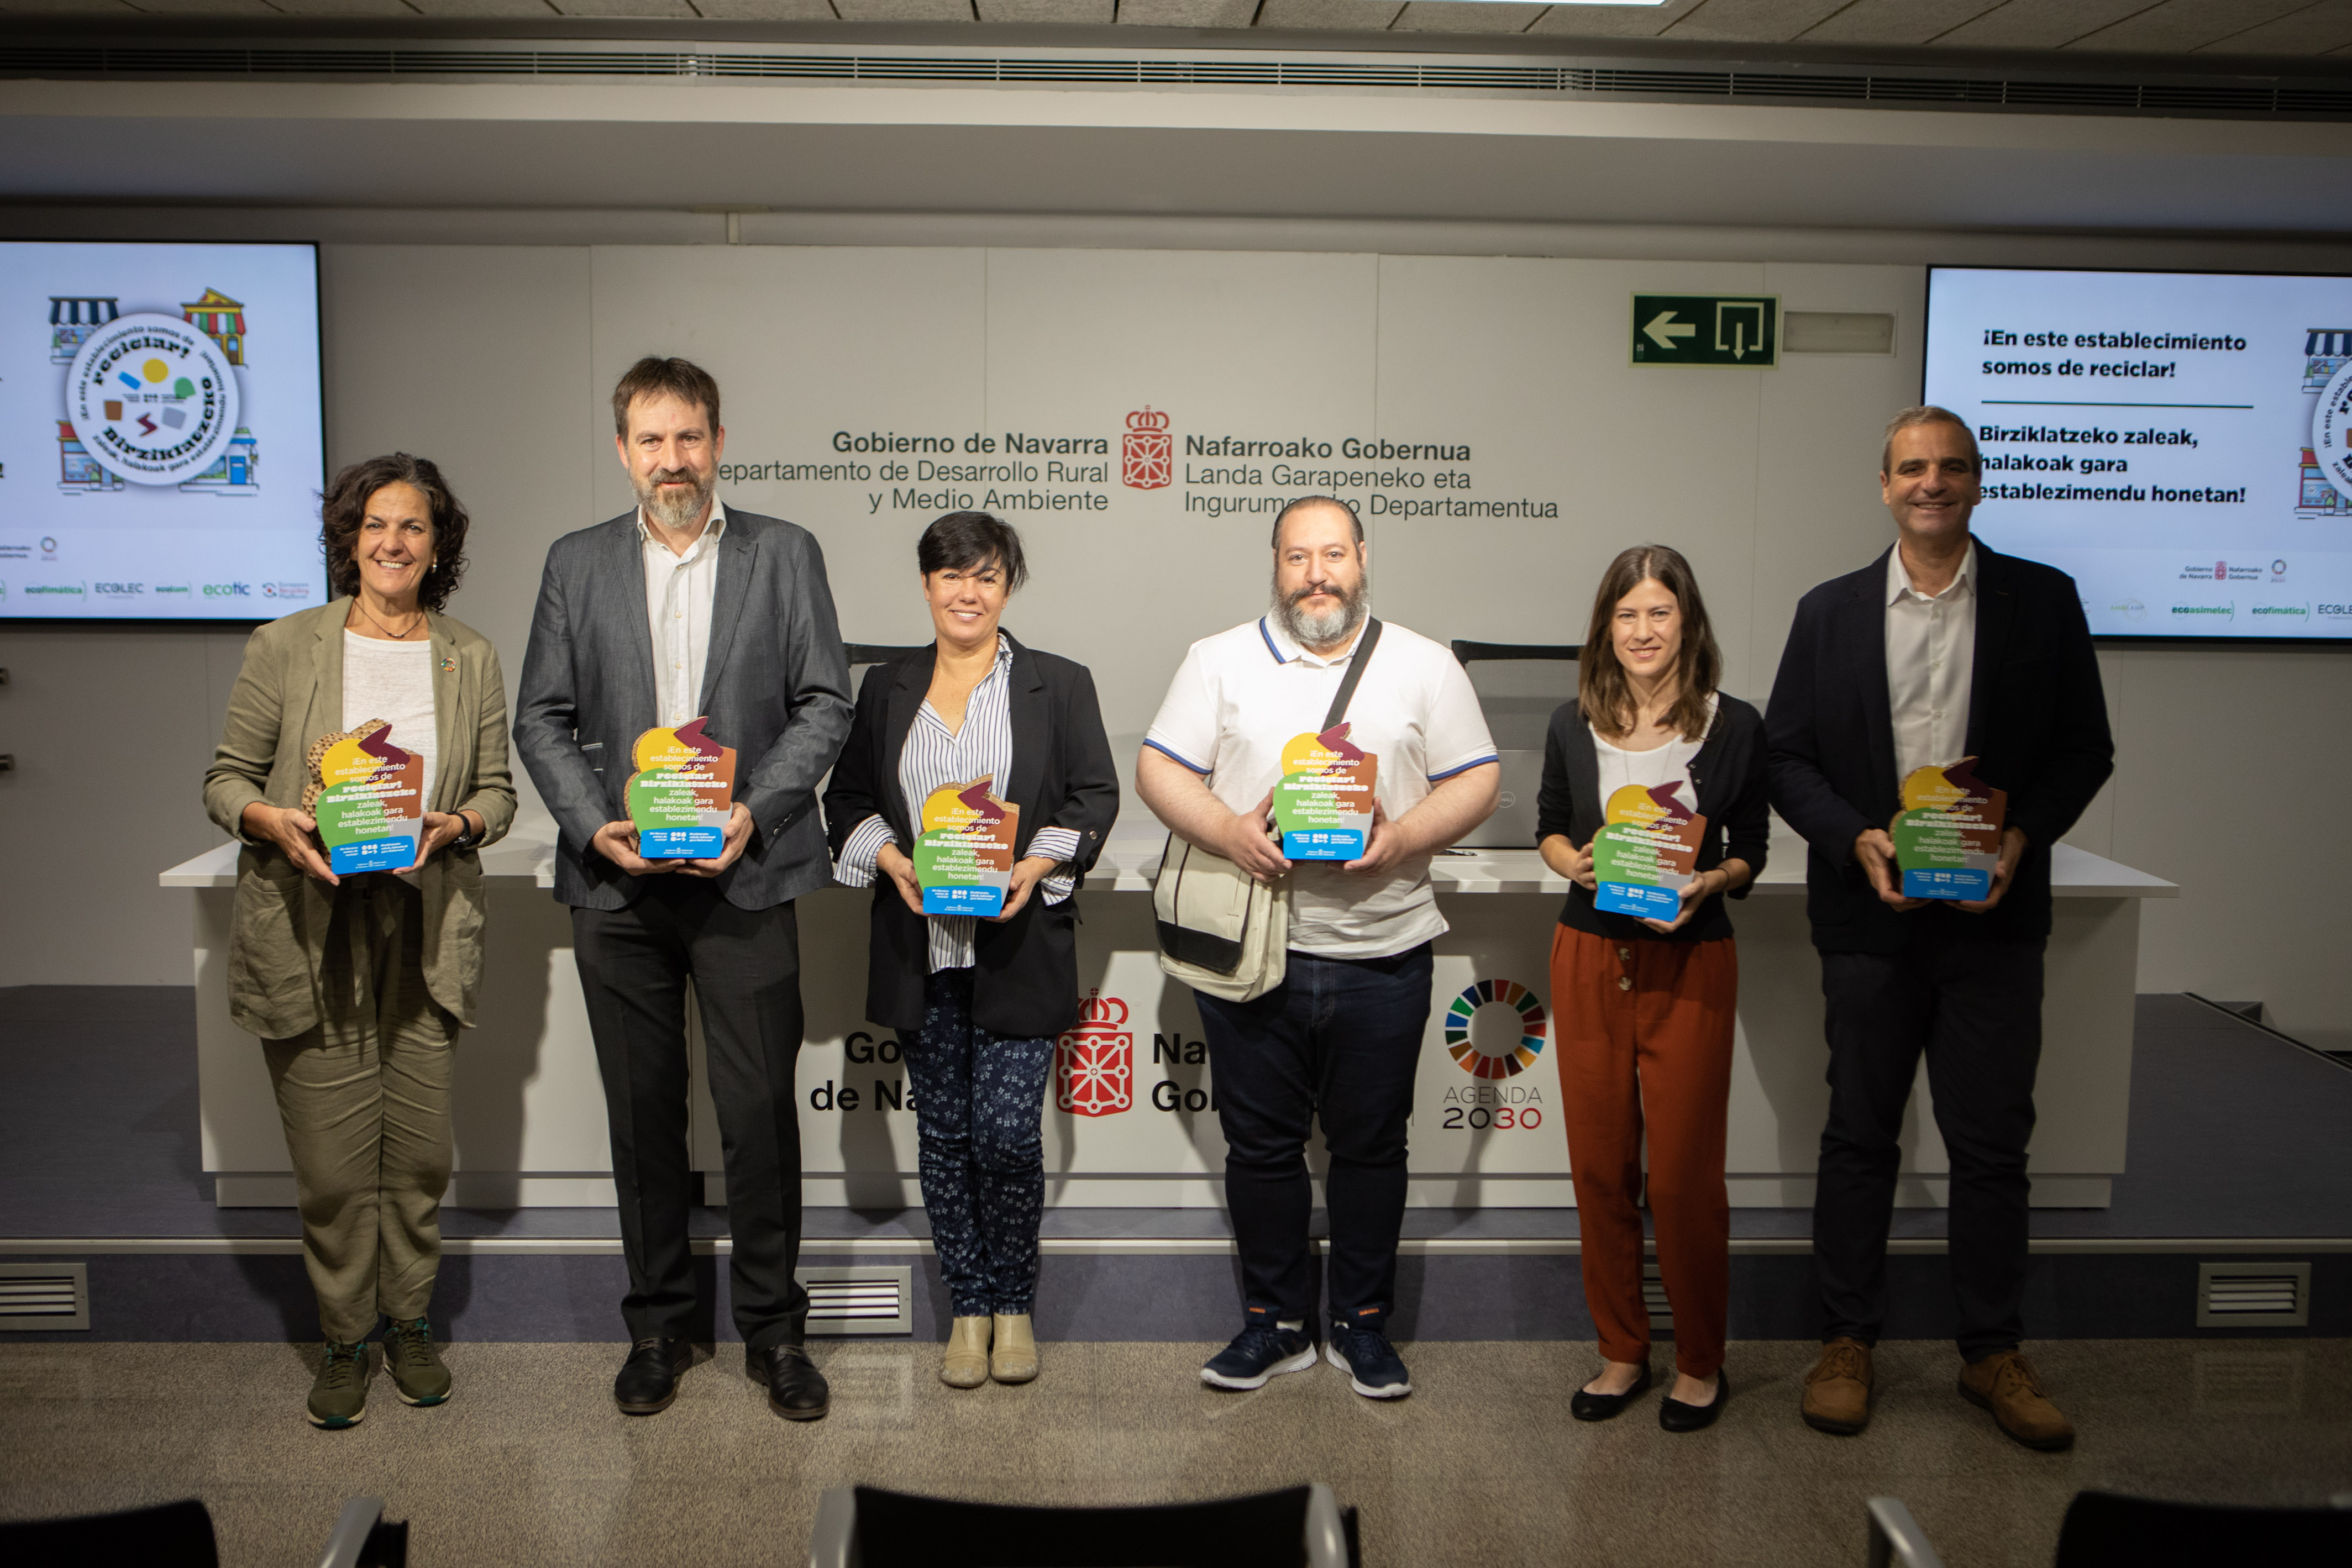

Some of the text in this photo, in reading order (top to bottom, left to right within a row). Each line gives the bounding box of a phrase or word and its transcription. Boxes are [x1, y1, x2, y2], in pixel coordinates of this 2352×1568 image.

[1983, 330, 2246, 351] ¡En este establecimiento
[1982, 359, 2176, 378] somos de reciclar!
[832, 431, 1108, 454] Gobierno de Navarra
[1980, 426, 2198, 448] Birziklatzeko zaleak,
[1186, 435, 1470, 460] Nafarroako Gobernua
[1980, 454, 2128, 474] halakoak gara
[719, 460, 1108, 485] epartamento de Desarrollo Rural
[1186, 463, 1471, 491] Landa Garapeneko eta
[1980, 482, 2246, 503] establezimendu honetan!
[869, 488, 1108, 514] y Medio Ambiente
[1186, 491, 1558, 520] Ingurumo Departamentua
[203, 582, 250, 595] ecotic
[2172, 606, 2232, 615] ecoasimelec
[2252, 606, 2306, 615] ecofimática
[335, 764, 406, 775] establecimiento
[350, 774, 378, 782] somos
[669, 789, 699, 797] zaleak,
[1311, 792, 1340, 800] zaleak,
[1917, 794, 1988, 804] establecimiento
[357, 799, 387, 808] zaleak,
[1654, 806, 1672, 814] este
[342, 809, 381, 818] halakoak
[935, 816, 1000, 824] establecimiento
[1620, 809, 1688, 825] establecimiento
[338, 815, 408, 828] establezimendu
[1632, 820, 1660, 829] somos
[355, 825, 393, 834] honetan!
[1935, 830, 1966, 838] zaleak,
[1632, 845, 1662, 857] zaleak,
[1914, 846, 1985, 855] establezimendu
[1616, 851, 1677, 867] halakoak gara
[1611, 860, 1679, 875] establezimendu
[1626, 869, 1663, 881] honetan!
[810, 1080, 859, 1111] de
[1443, 1086, 1542, 1104] AGENDA
[1443, 1107, 1542, 1129] 2030
